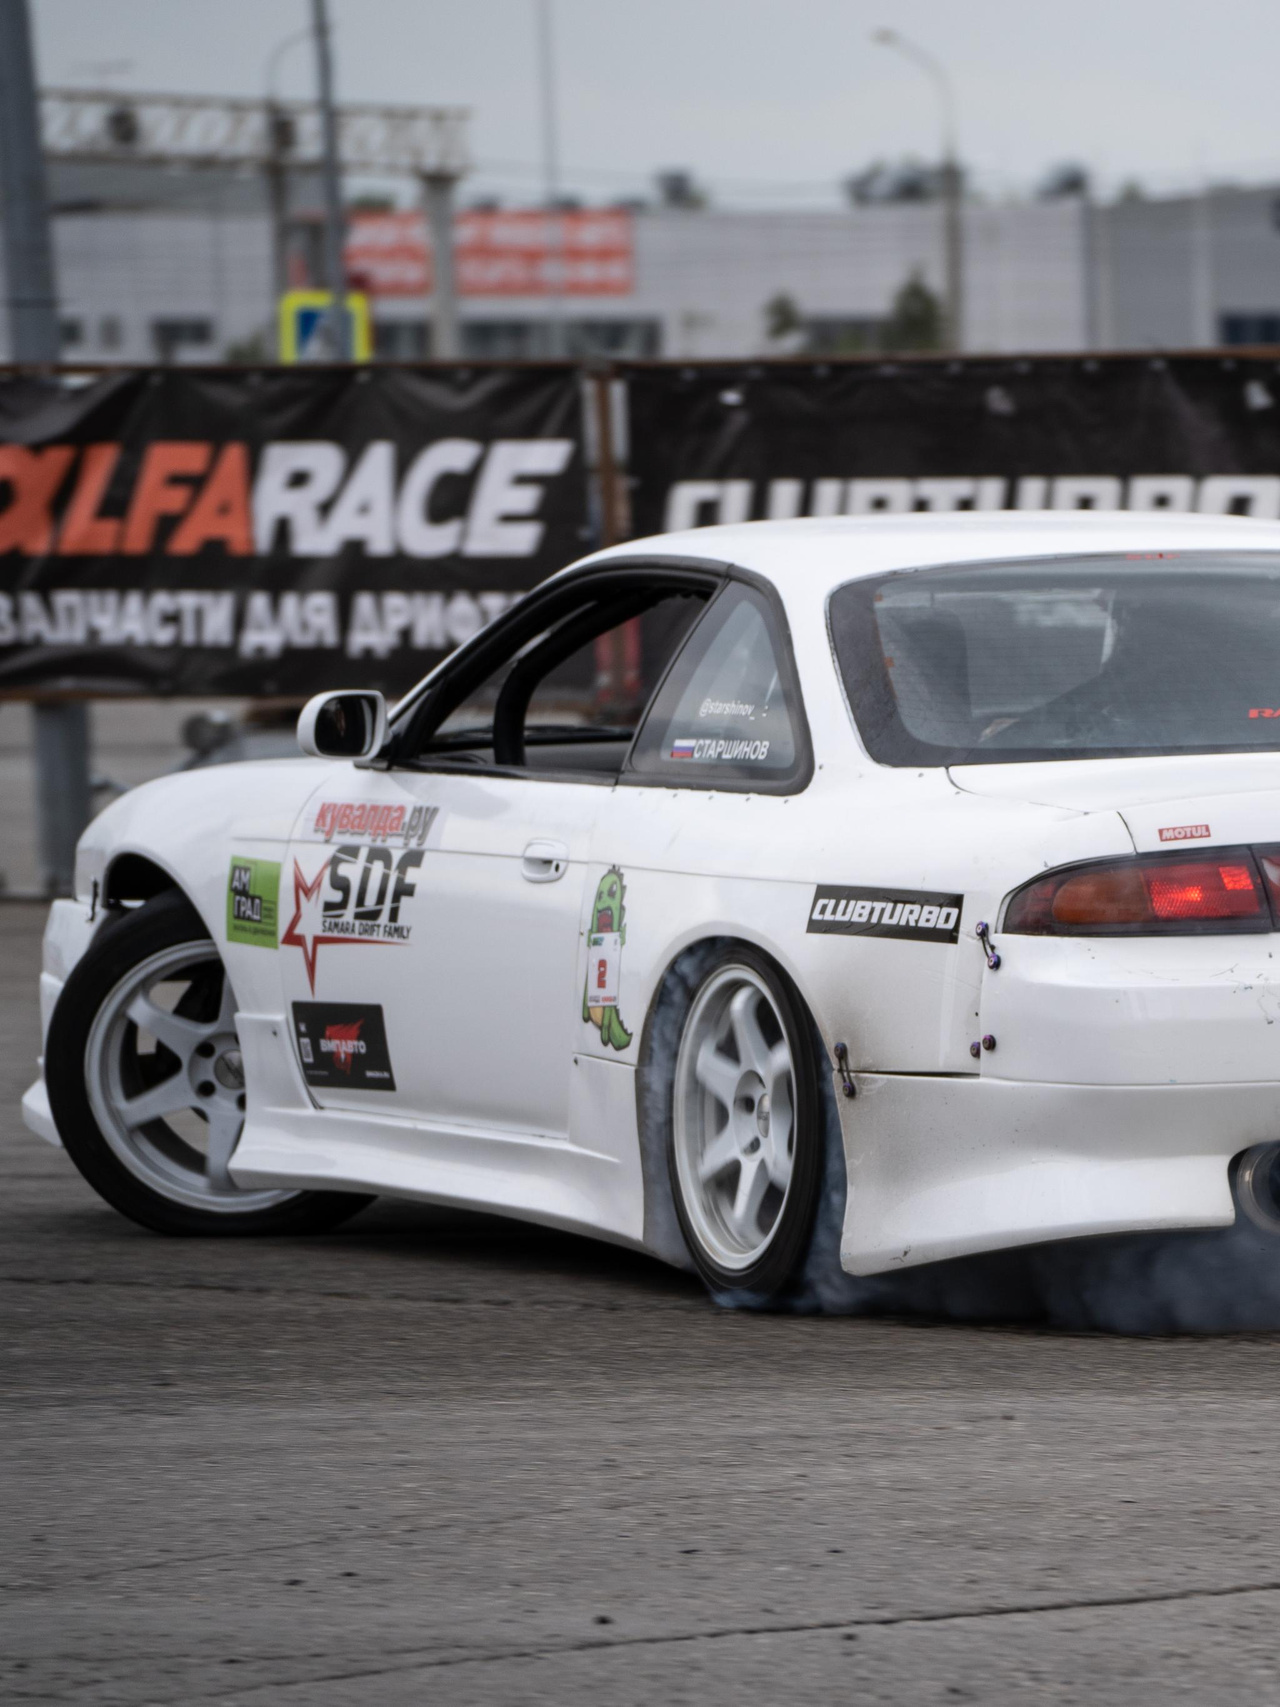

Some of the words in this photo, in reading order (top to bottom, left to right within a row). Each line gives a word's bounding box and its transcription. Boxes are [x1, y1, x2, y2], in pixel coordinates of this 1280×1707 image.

[239, 591, 338, 660] ДЛЯ
[346, 590, 530, 660] ДРИФТ
[693, 739, 770, 760] СТАРШИНОВ
[314, 803, 440, 847] кувалда.ру
[1161, 826, 1210, 841] MOTUL
[322, 845, 426, 923] SDF
[234, 894, 262, 920] ГРАД
[811, 898, 960, 930] CLUBTURBO
[322, 919, 356, 934] SAMARA
[357, 922, 382, 937] DRIFT
[383, 924, 412, 939] FAMILY
